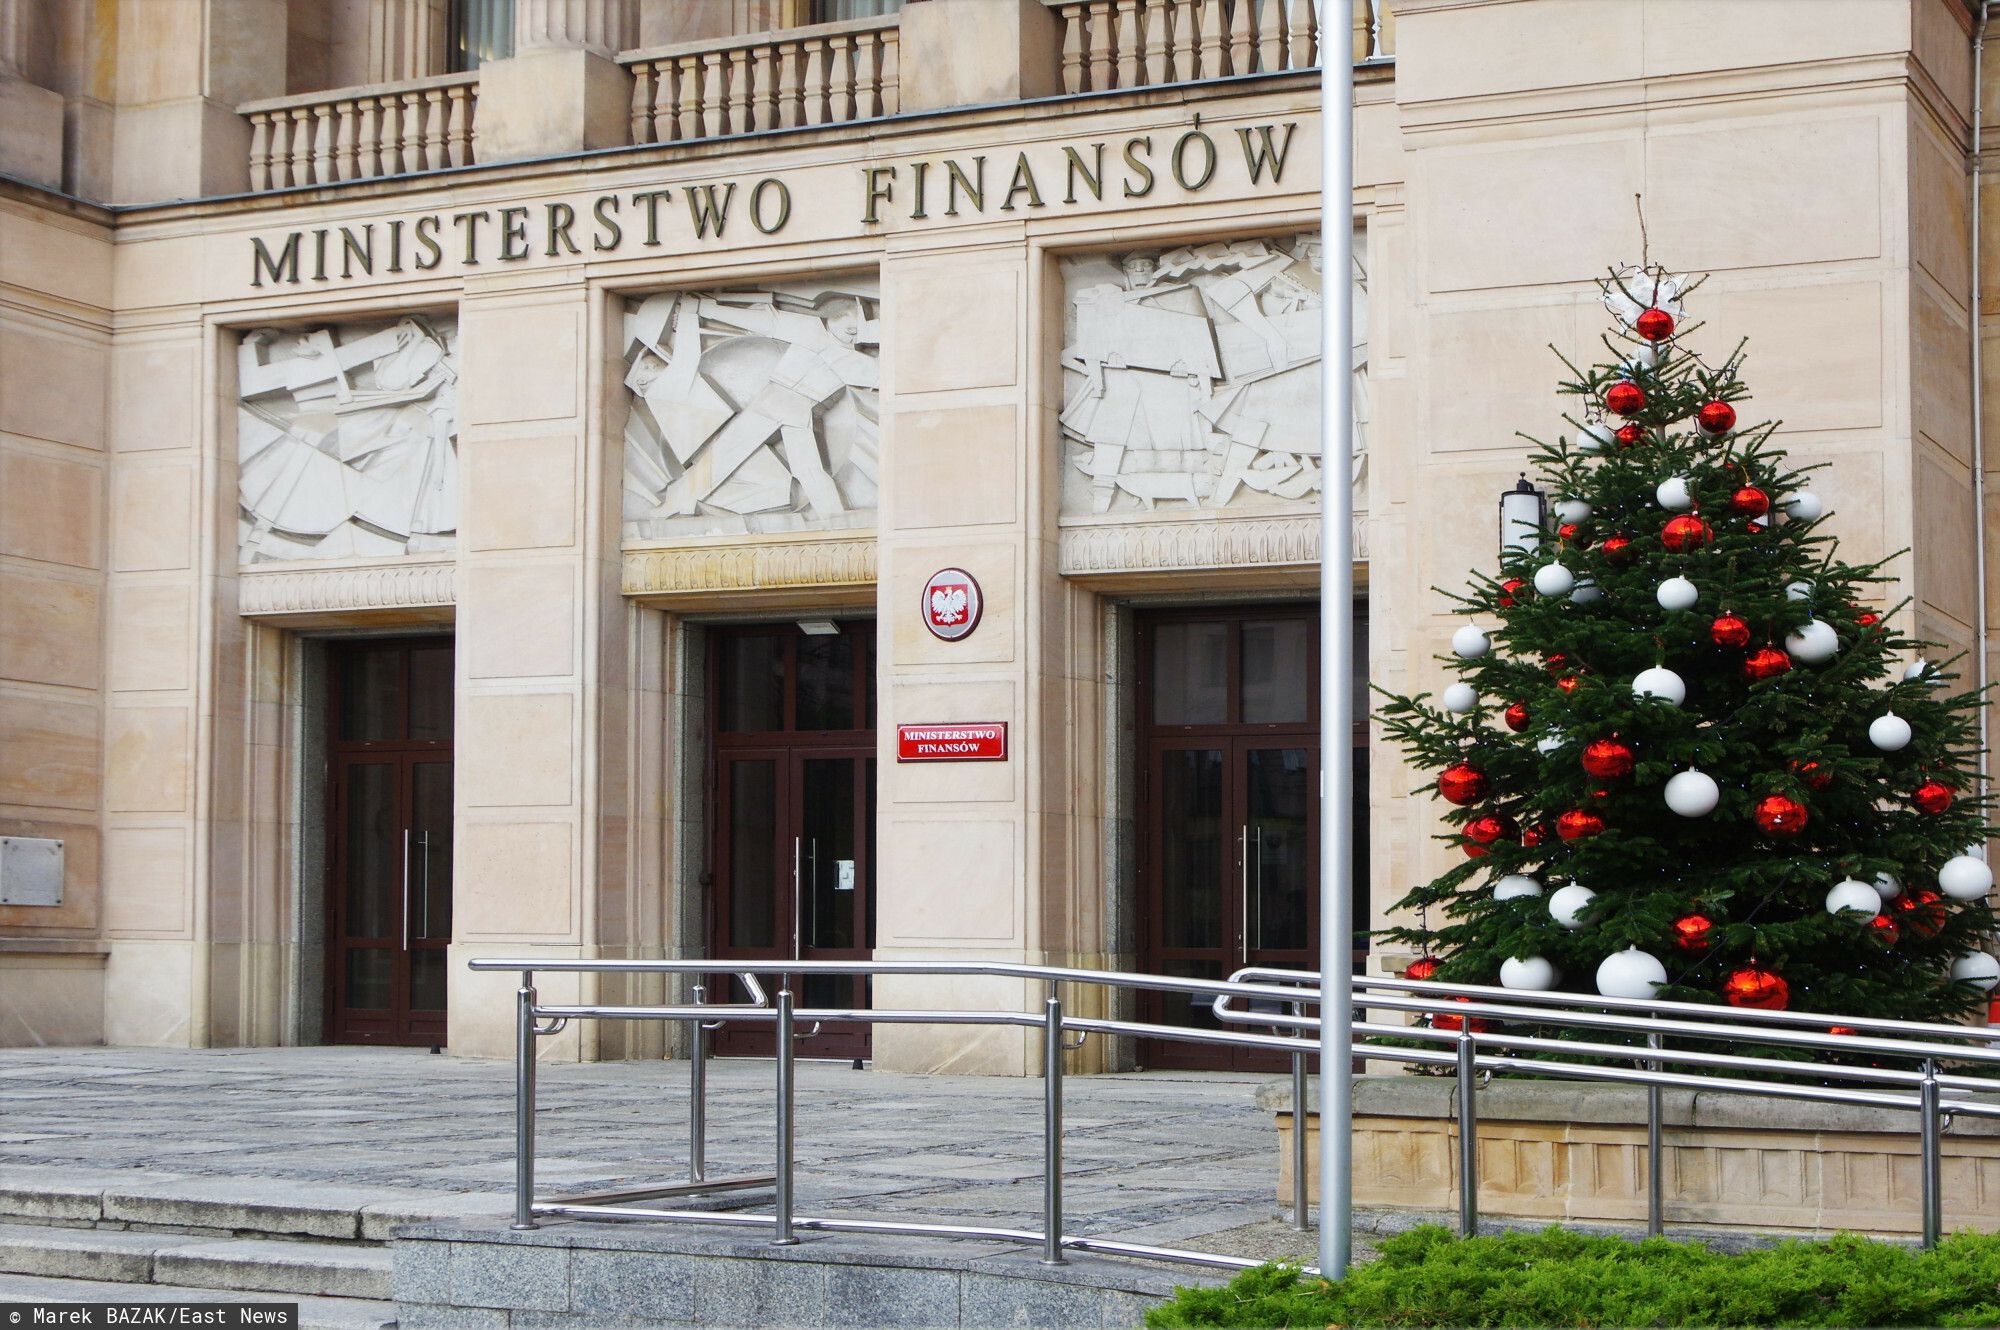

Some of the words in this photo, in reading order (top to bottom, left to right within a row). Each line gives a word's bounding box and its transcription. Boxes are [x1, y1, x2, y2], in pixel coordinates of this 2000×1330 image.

[250, 178, 791, 287] MINISTERSTWO
[861, 113, 1297, 223] FINANSÓW
[904, 730, 995, 741] MINISTERSTWO
[918, 743, 980, 753] FINANSÓW
